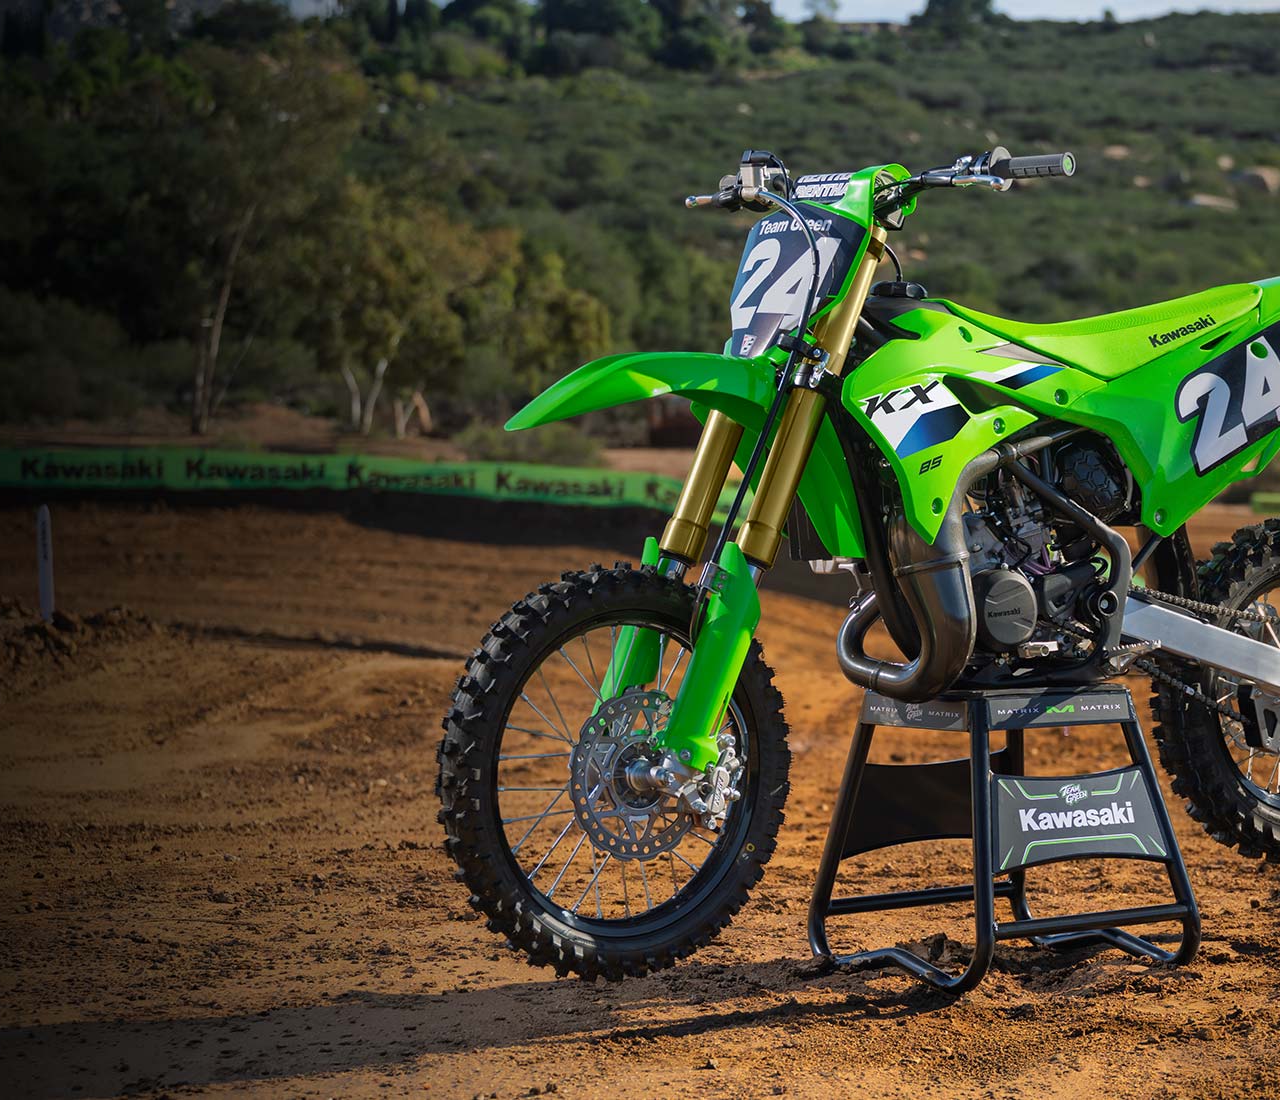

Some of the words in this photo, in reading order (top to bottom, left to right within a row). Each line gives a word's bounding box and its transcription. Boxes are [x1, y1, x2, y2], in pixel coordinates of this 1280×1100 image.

[759, 219, 789, 235] Team
[730, 236, 842, 331] 24
[1148, 314, 1217, 348] Kawasaki
[864, 380, 940, 420] KX
[22, 456, 164, 480] Kawasaki
[185, 458, 325, 481] Kawasaki
[494, 469, 625, 497] Kawasaki
[919, 455, 943, 476] 85
[870, 705, 898, 713] MATRIX
[997, 707, 1040, 715] MATRIX
[1080, 703, 1121, 711] MATRIX
[1018, 801, 1135, 832] Kawasaki
